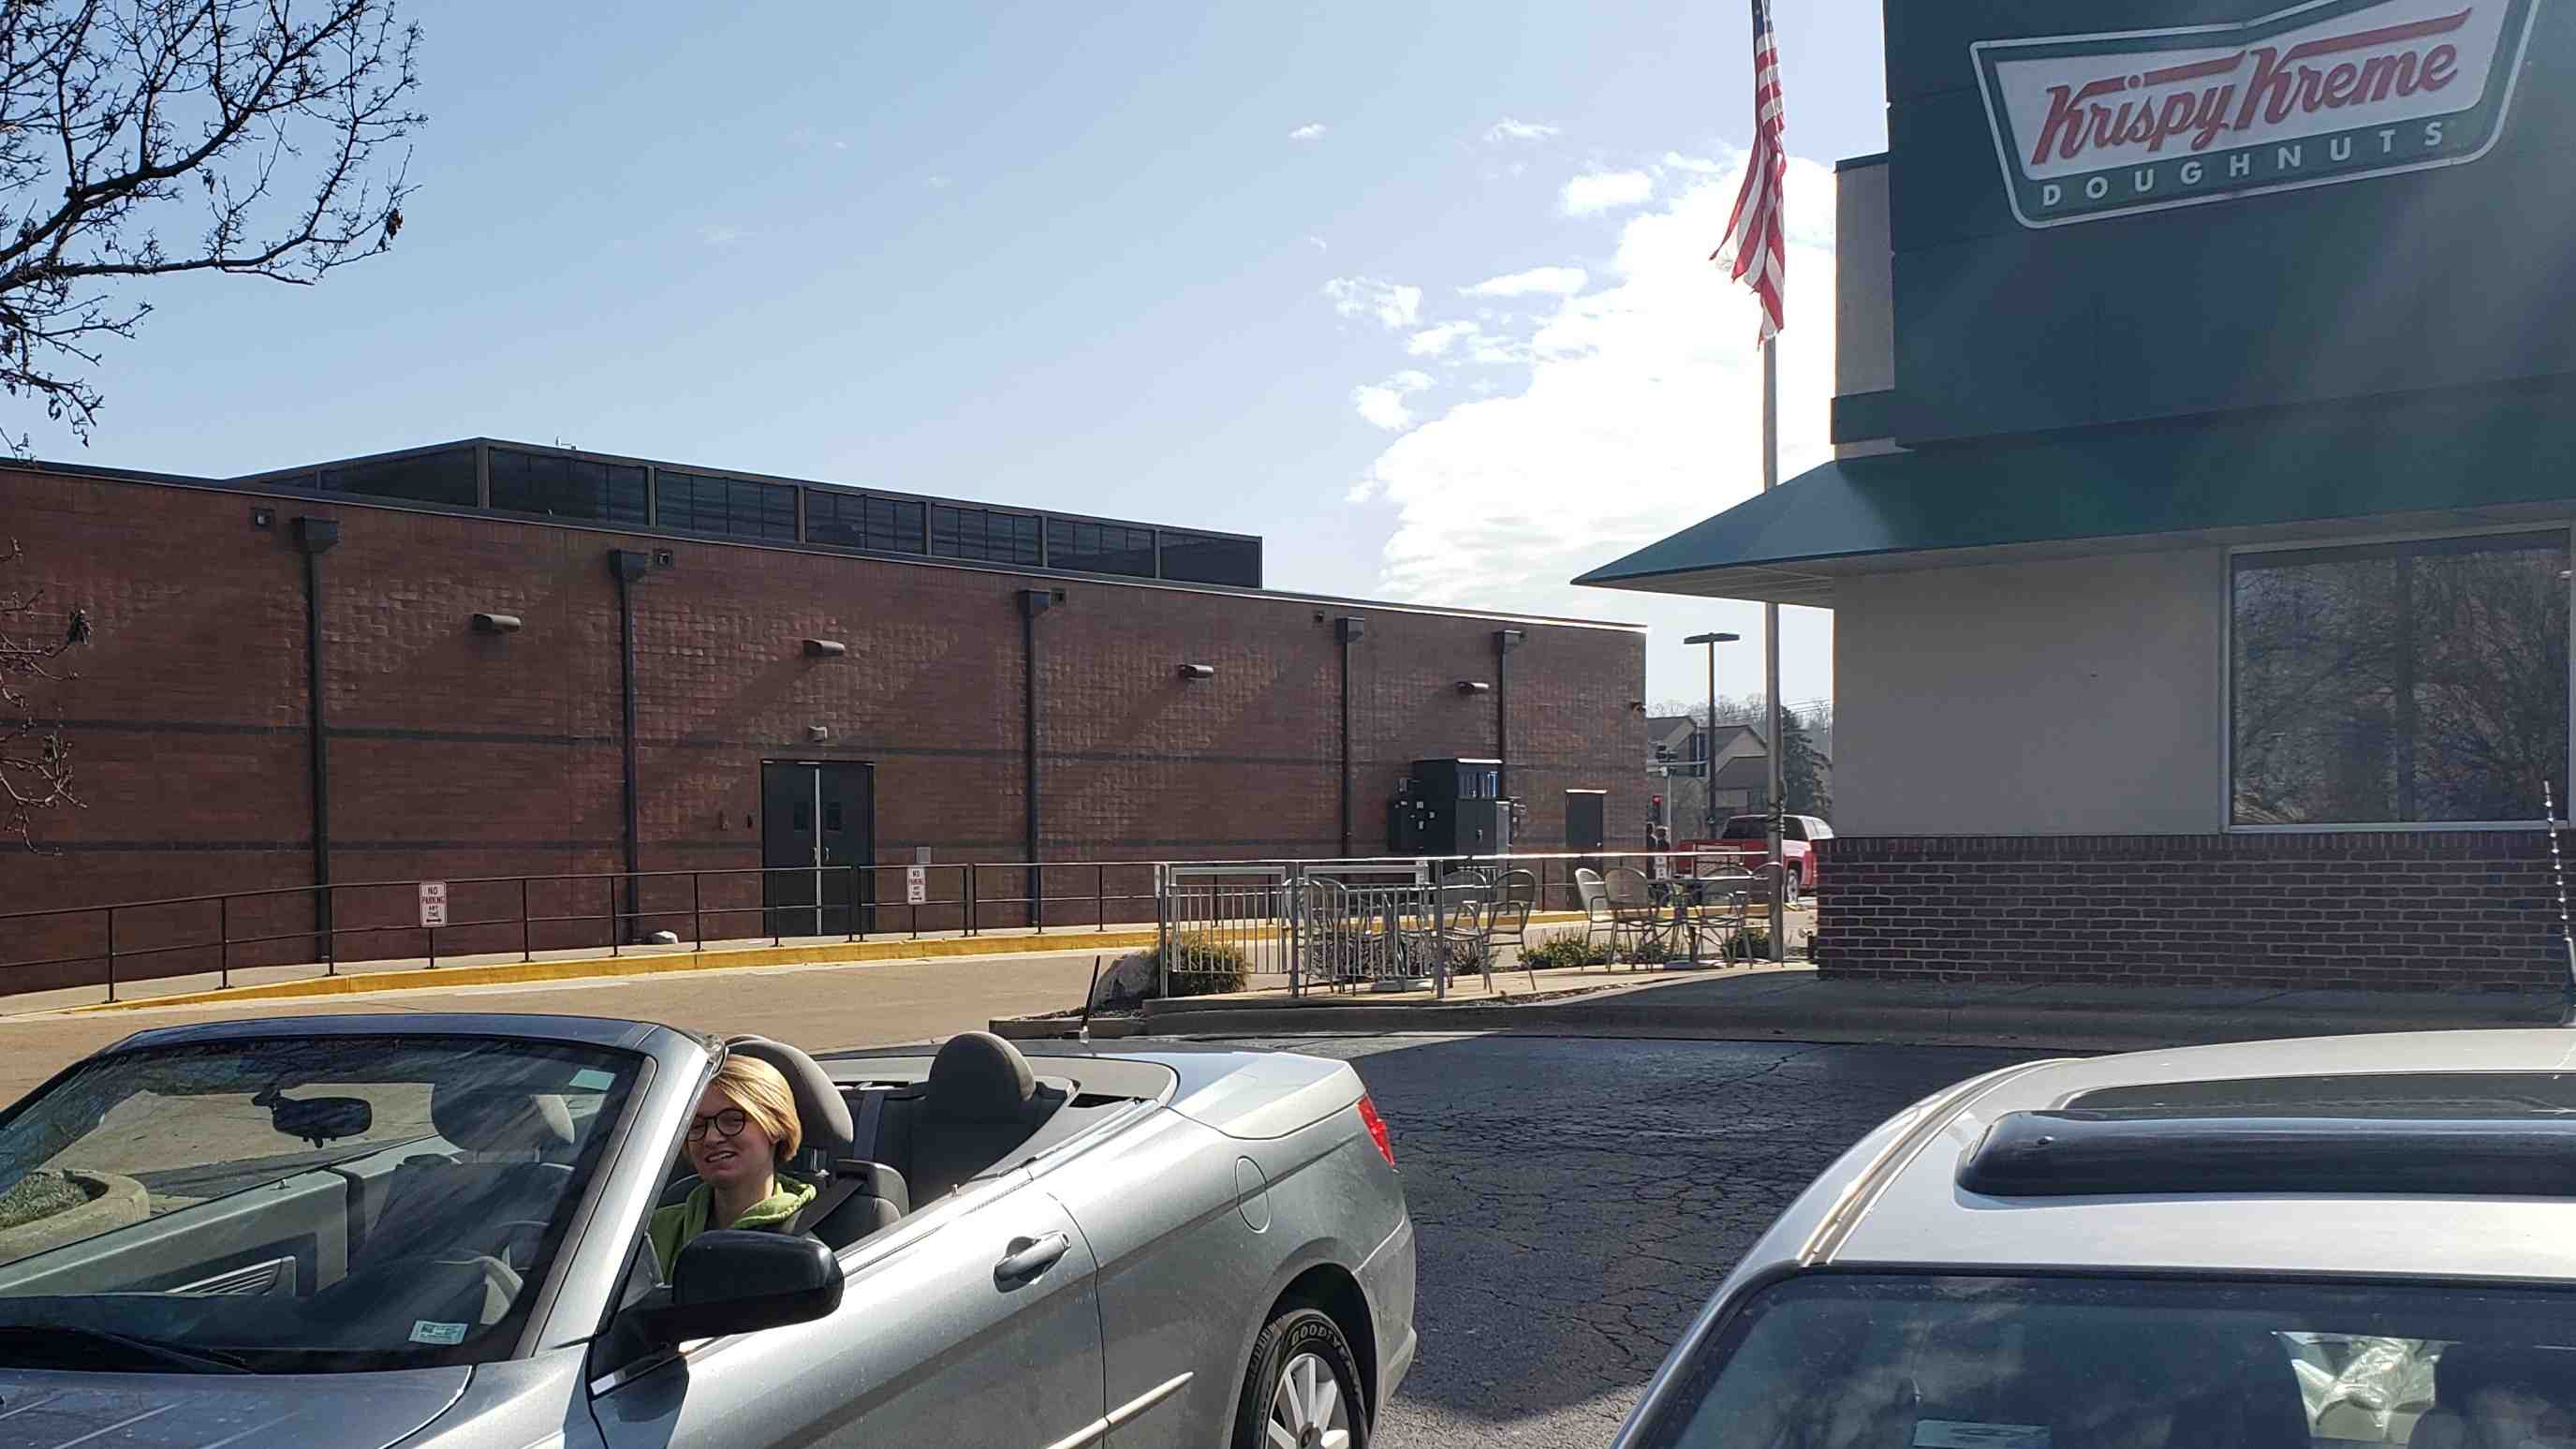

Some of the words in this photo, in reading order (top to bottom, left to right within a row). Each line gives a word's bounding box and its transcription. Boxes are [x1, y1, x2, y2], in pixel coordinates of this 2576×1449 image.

[2030, 50, 2246, 166] Krispy
[2232, 7, 2474, 132] Kreme
[2042, 122, 2443, 207] DOUGHNUTS
[428, 886, 438, 895] NO
